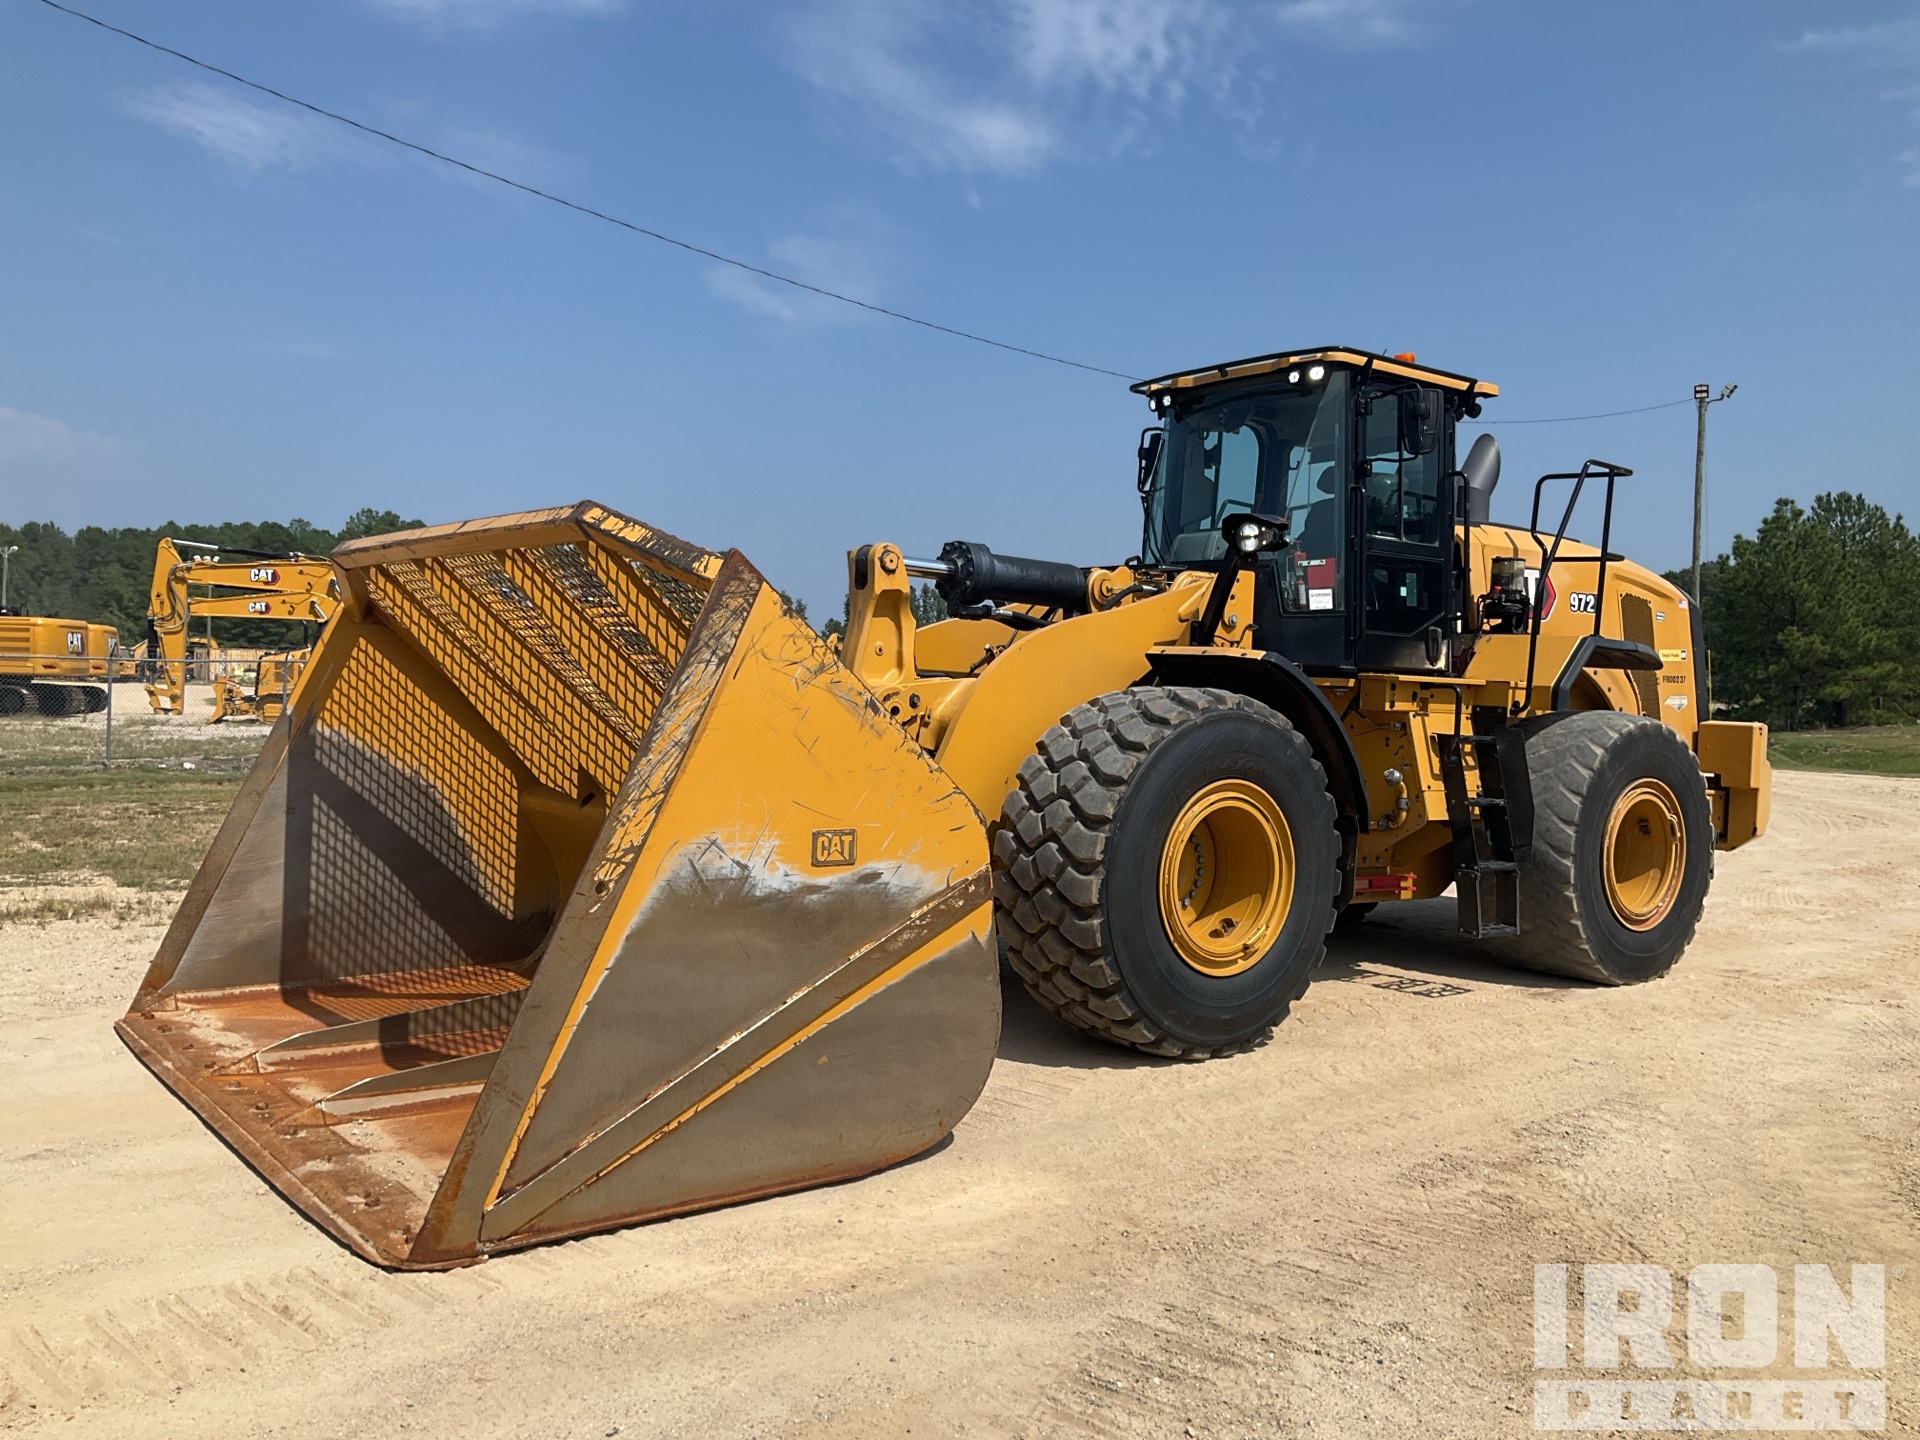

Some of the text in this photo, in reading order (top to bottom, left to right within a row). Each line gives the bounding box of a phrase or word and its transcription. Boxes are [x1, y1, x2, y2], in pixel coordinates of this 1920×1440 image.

[250, 568, 274, 582] CAT
[249, 602, 267, 613] CAT
[1569, 592, 1595, 613] 972
[67, 632, 82, 652] CAT
[816, 834, 853, 862] CAT
